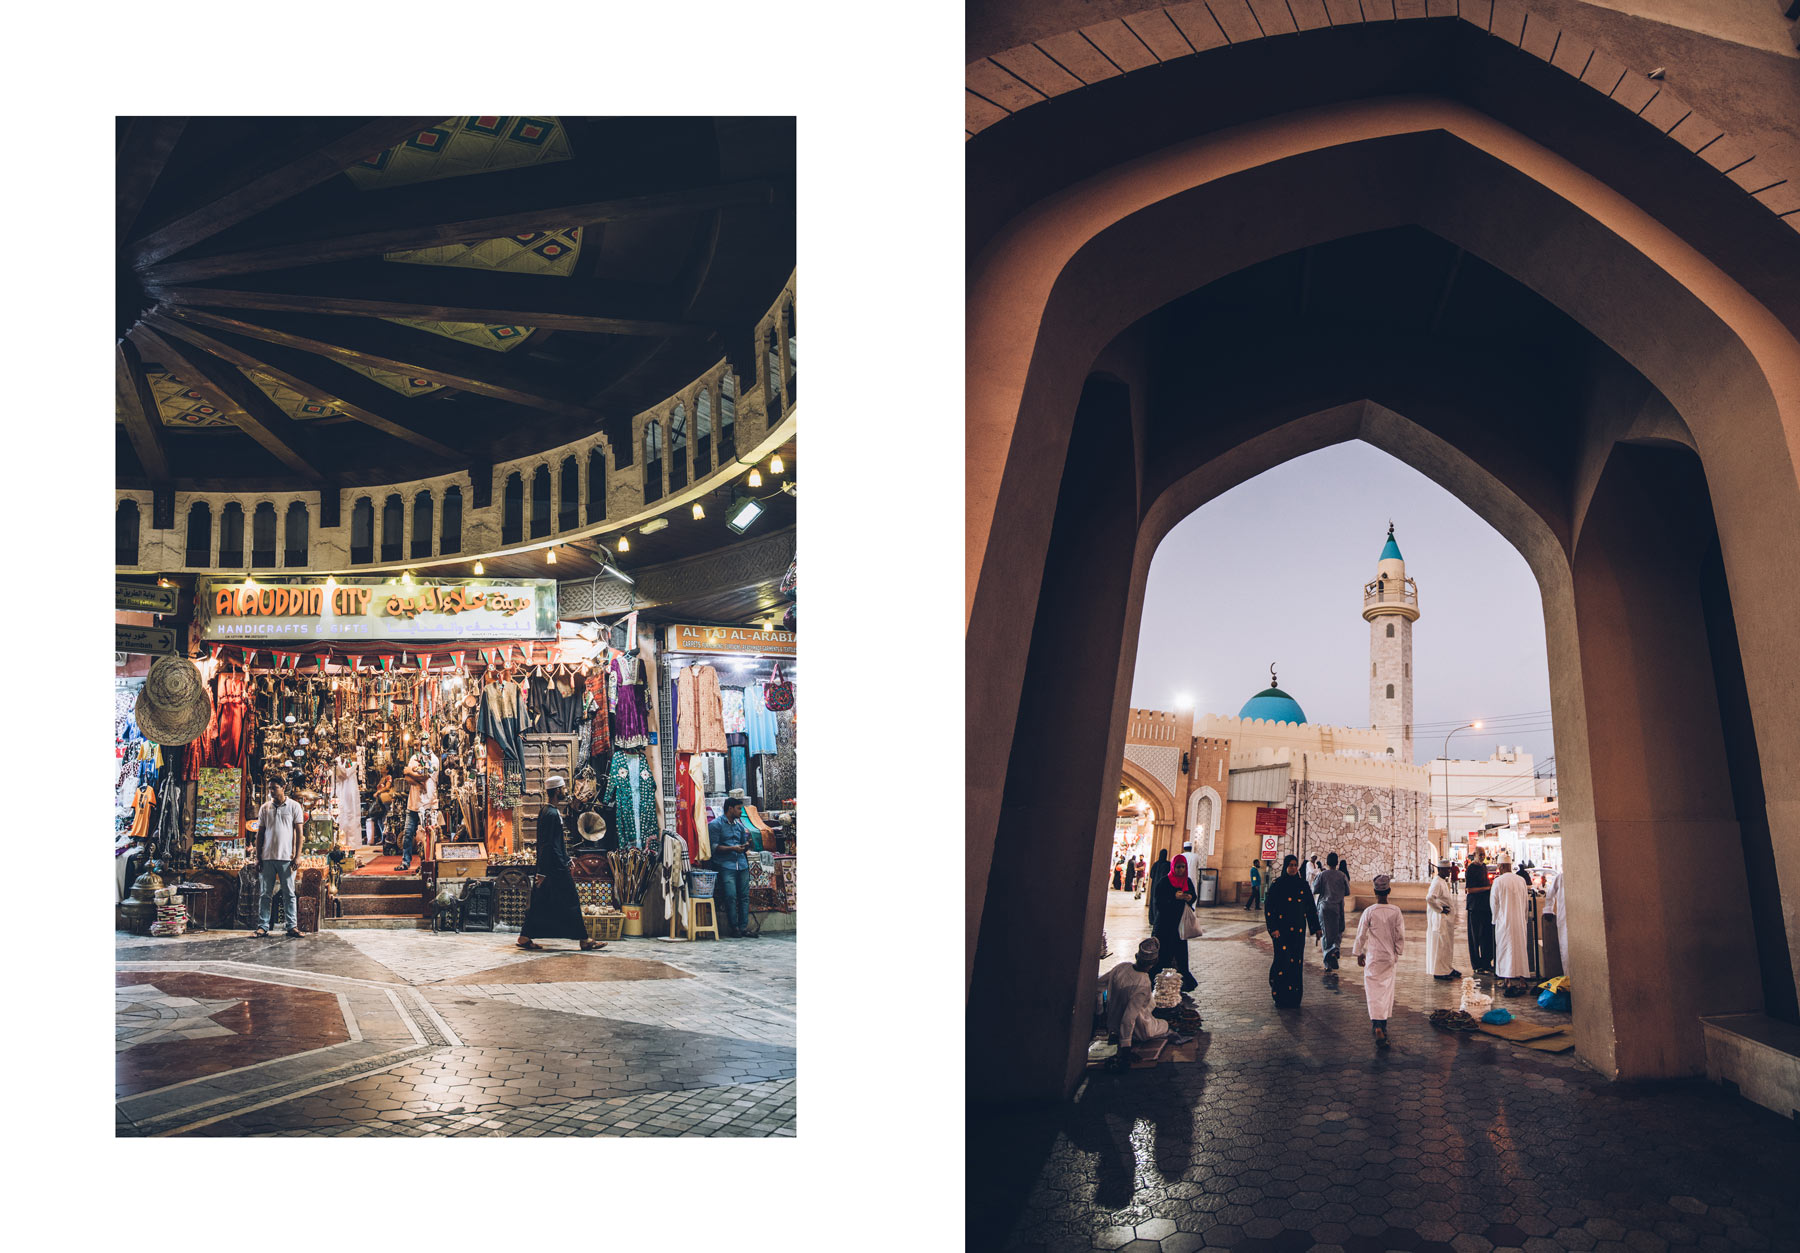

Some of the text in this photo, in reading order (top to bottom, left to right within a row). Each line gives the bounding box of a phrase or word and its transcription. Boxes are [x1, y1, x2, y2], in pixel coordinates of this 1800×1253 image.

[216, 587, 372, 616] ALAUDDIN CITY
[386, 586, 531, 620] مدينة علاء الدين
[217, 624, 308, 634] HANDICRAFTS
[330, 624, 369, 634] GIFTS
[682, 627, 700, 638] AL
[703, 628, 727, 639] TAJ
